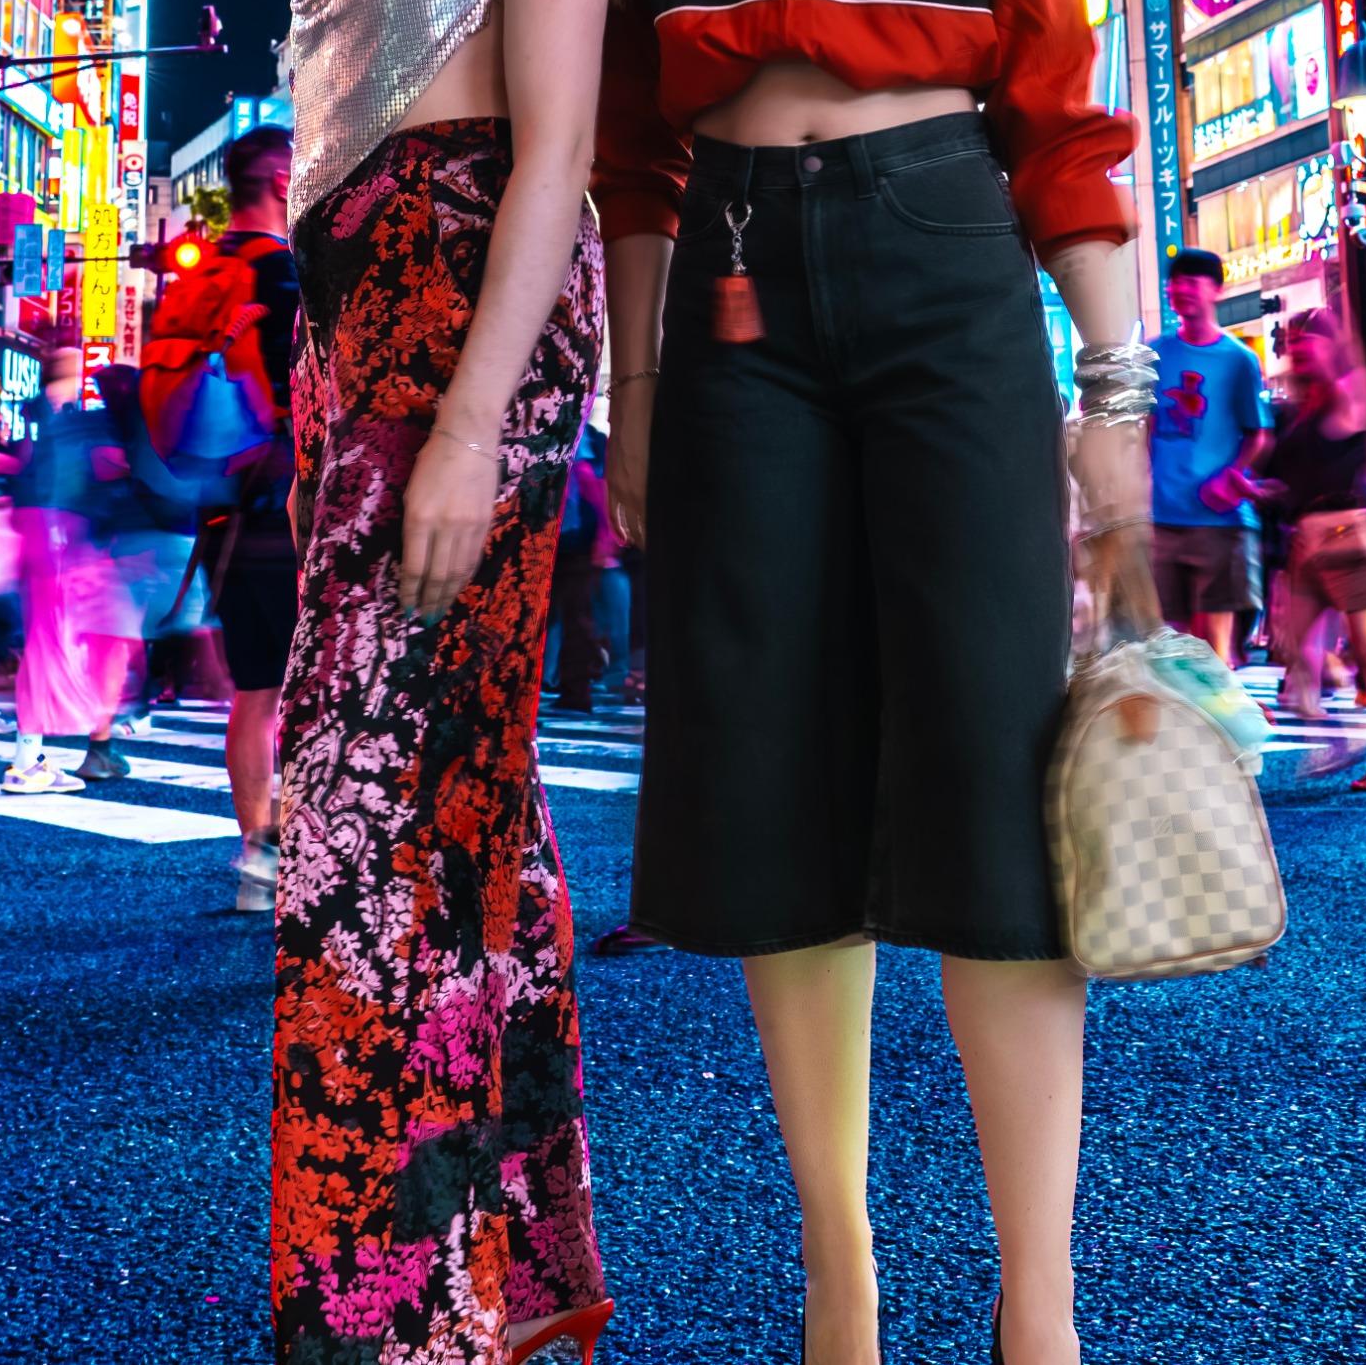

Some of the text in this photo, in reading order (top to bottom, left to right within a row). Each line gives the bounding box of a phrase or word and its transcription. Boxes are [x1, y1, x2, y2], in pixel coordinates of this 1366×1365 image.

[1148, 20, 1179, 236] サマーフルーツギフト
[92, 208, 114, 332] 処方せん
[3, 348, 42, 400] LUSH
